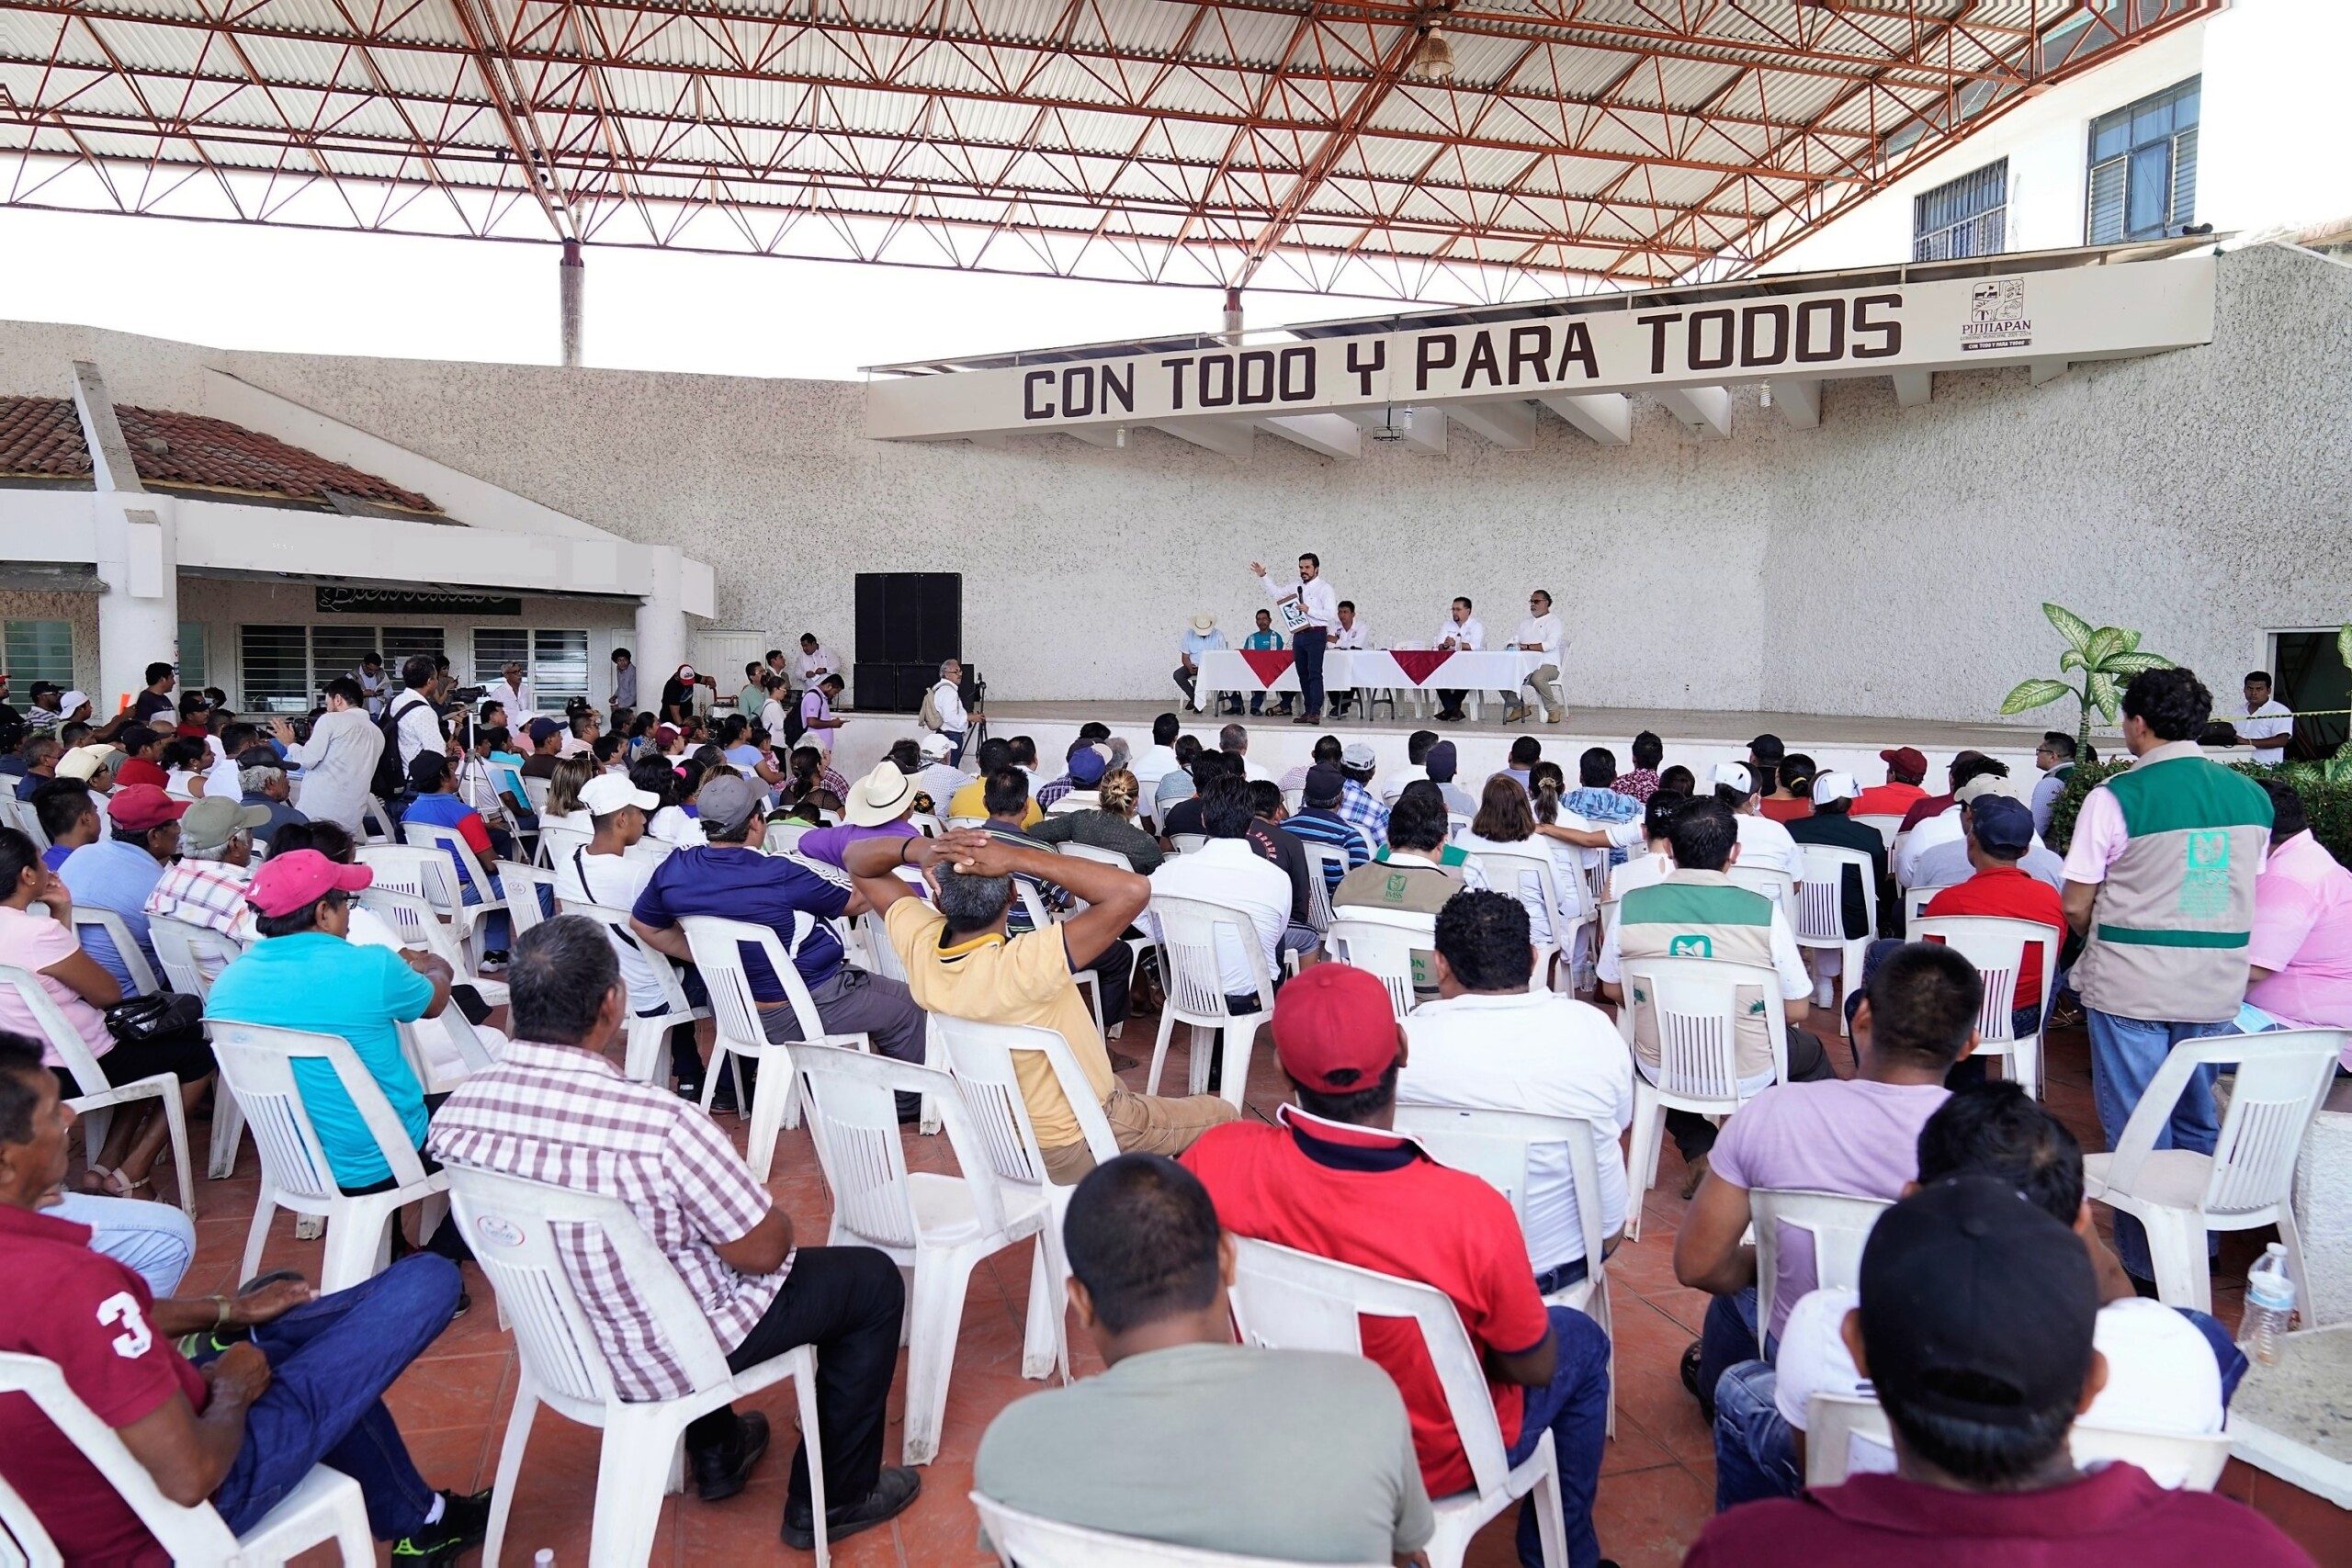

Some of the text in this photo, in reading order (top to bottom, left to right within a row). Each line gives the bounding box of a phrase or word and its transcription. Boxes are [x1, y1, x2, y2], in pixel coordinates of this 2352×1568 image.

[1962, 320, 2031, 334] PIJIJIAPAN
[1024, 294, 1902, 419] CON TODO Y PARA TODOS
[1288, 617, 1306, 627] IMSS
[1385, 890, 1402, 899] IMSS
[96, 1291, 153, 1359] 3
